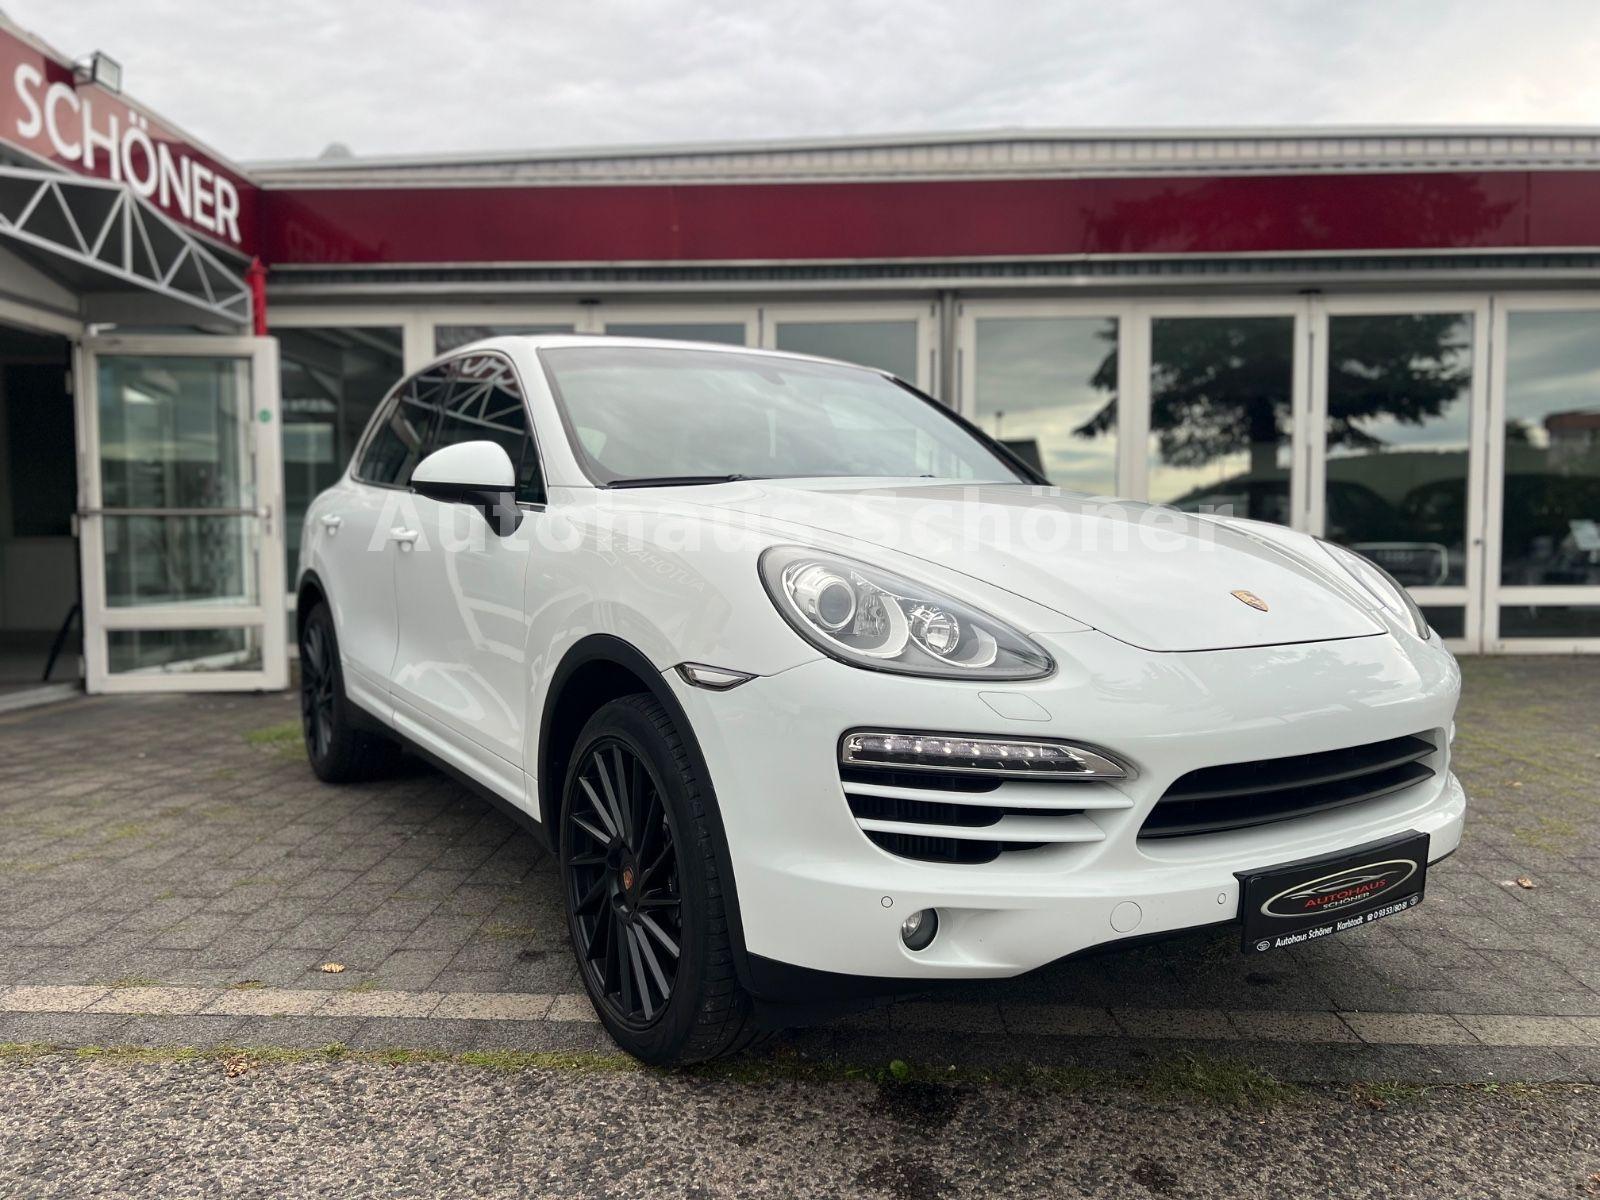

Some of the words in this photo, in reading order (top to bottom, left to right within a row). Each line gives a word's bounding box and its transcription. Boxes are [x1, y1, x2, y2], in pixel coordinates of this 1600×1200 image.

[14, 63, 241, 244] SCHÖNER
[1304, 879, 1387, 908] AUTOHAUS
[1322, 892, 1370, 910] SCHÖNER
[1275, 933, 1308, 948] Autohaus
[1308, 926, 1333, 940] Schöner
[1336, 915, 1364, 931] Karlstadt
